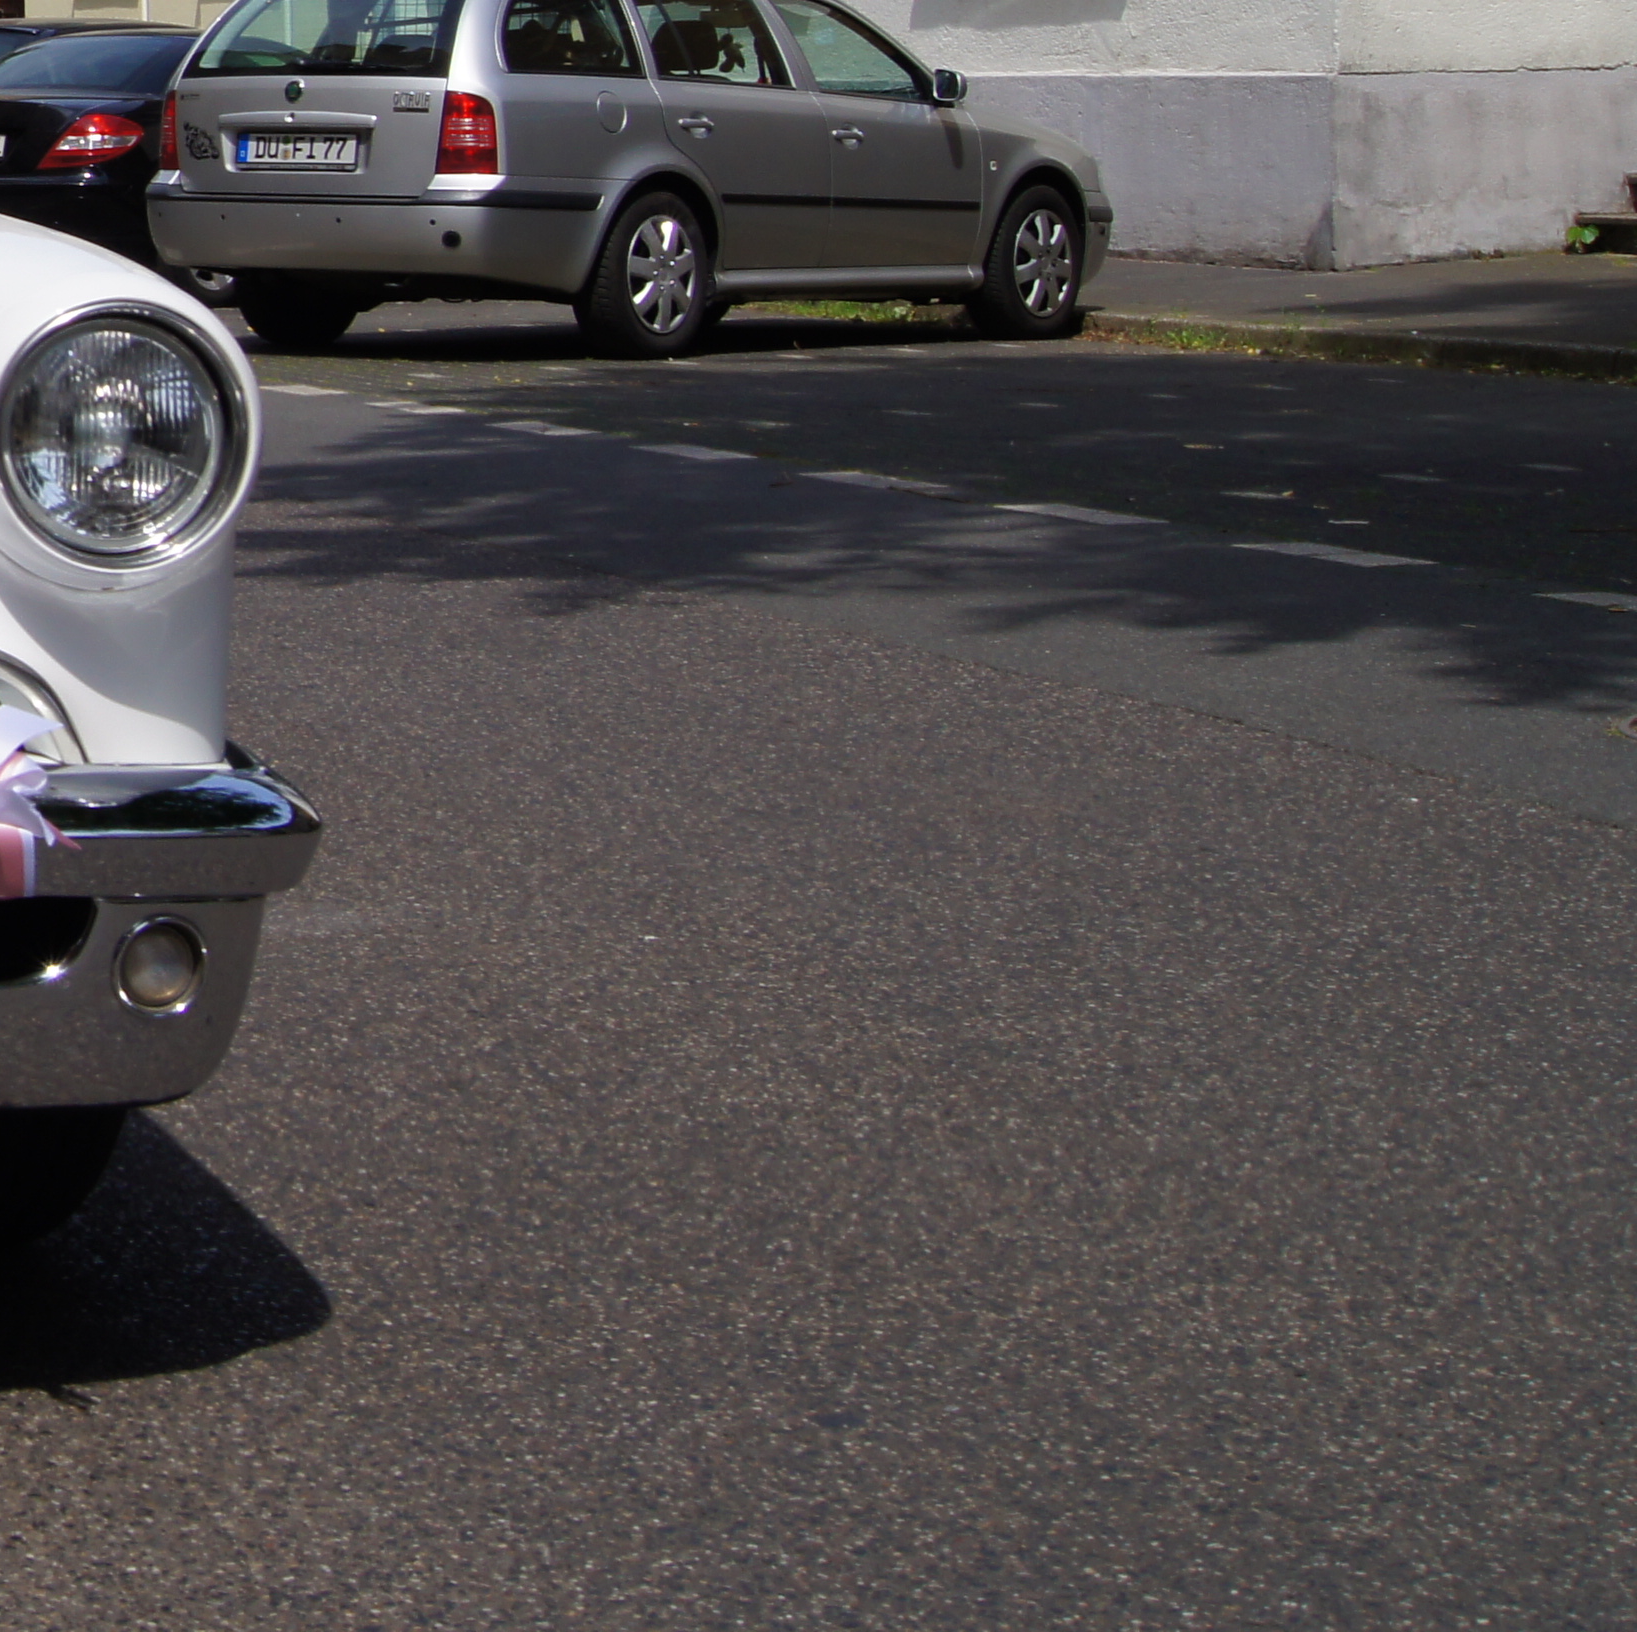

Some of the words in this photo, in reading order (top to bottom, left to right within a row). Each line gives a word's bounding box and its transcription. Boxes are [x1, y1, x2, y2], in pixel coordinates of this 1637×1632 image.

[254, 136, 280, 159] DU
[292, 136, 317, 160] FI
[323, 136, 348, 160] 77
